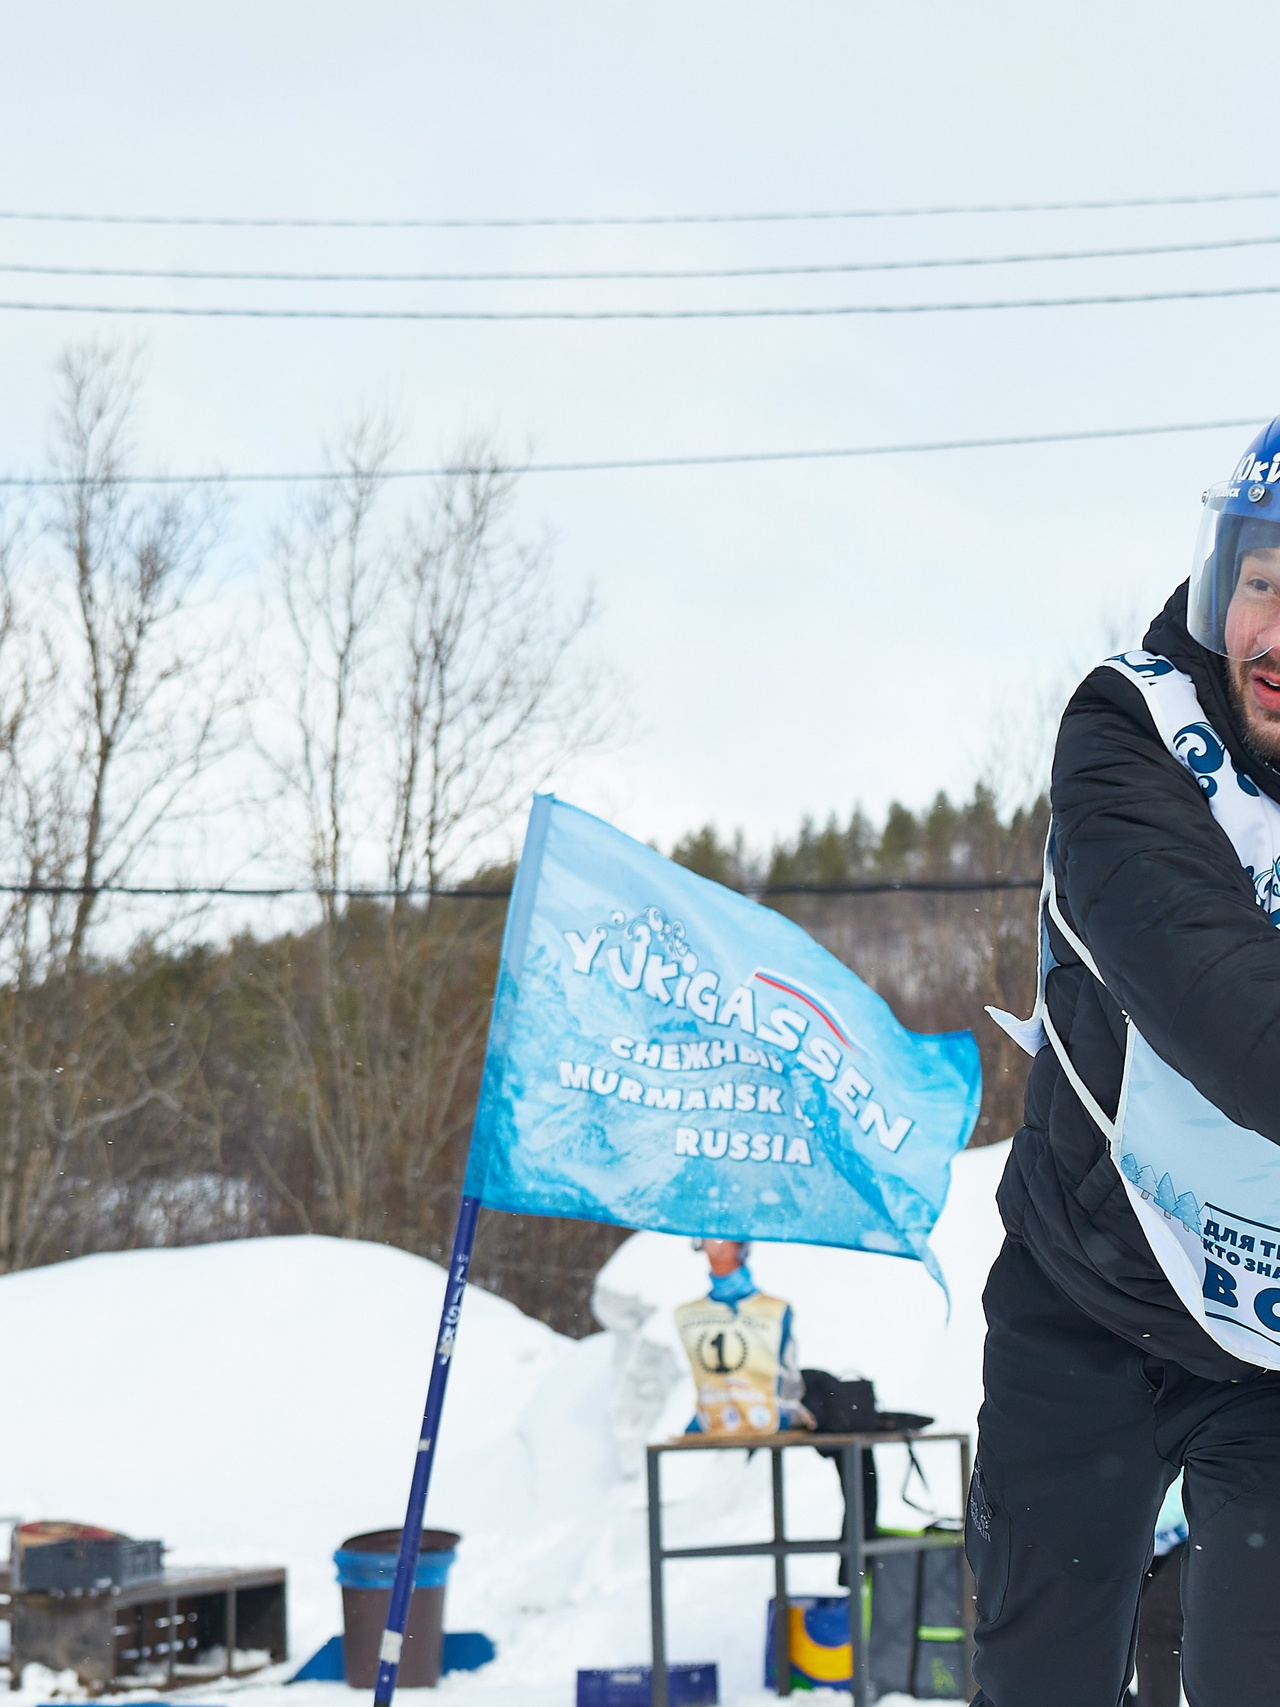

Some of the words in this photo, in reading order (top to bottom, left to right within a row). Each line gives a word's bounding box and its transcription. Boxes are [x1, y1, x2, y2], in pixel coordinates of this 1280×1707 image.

[559, 1060, 784, 1114] MURMANSK
[675, 1126, 813, 1166] RUSSIA
[1202, 1238, 1241, 1266] КТО
[1203, 1218, 1255, 1251] ДЛЯ
[1202, 1256, 1239, 1308] В
[710, 1332, 732, 1374] 1
